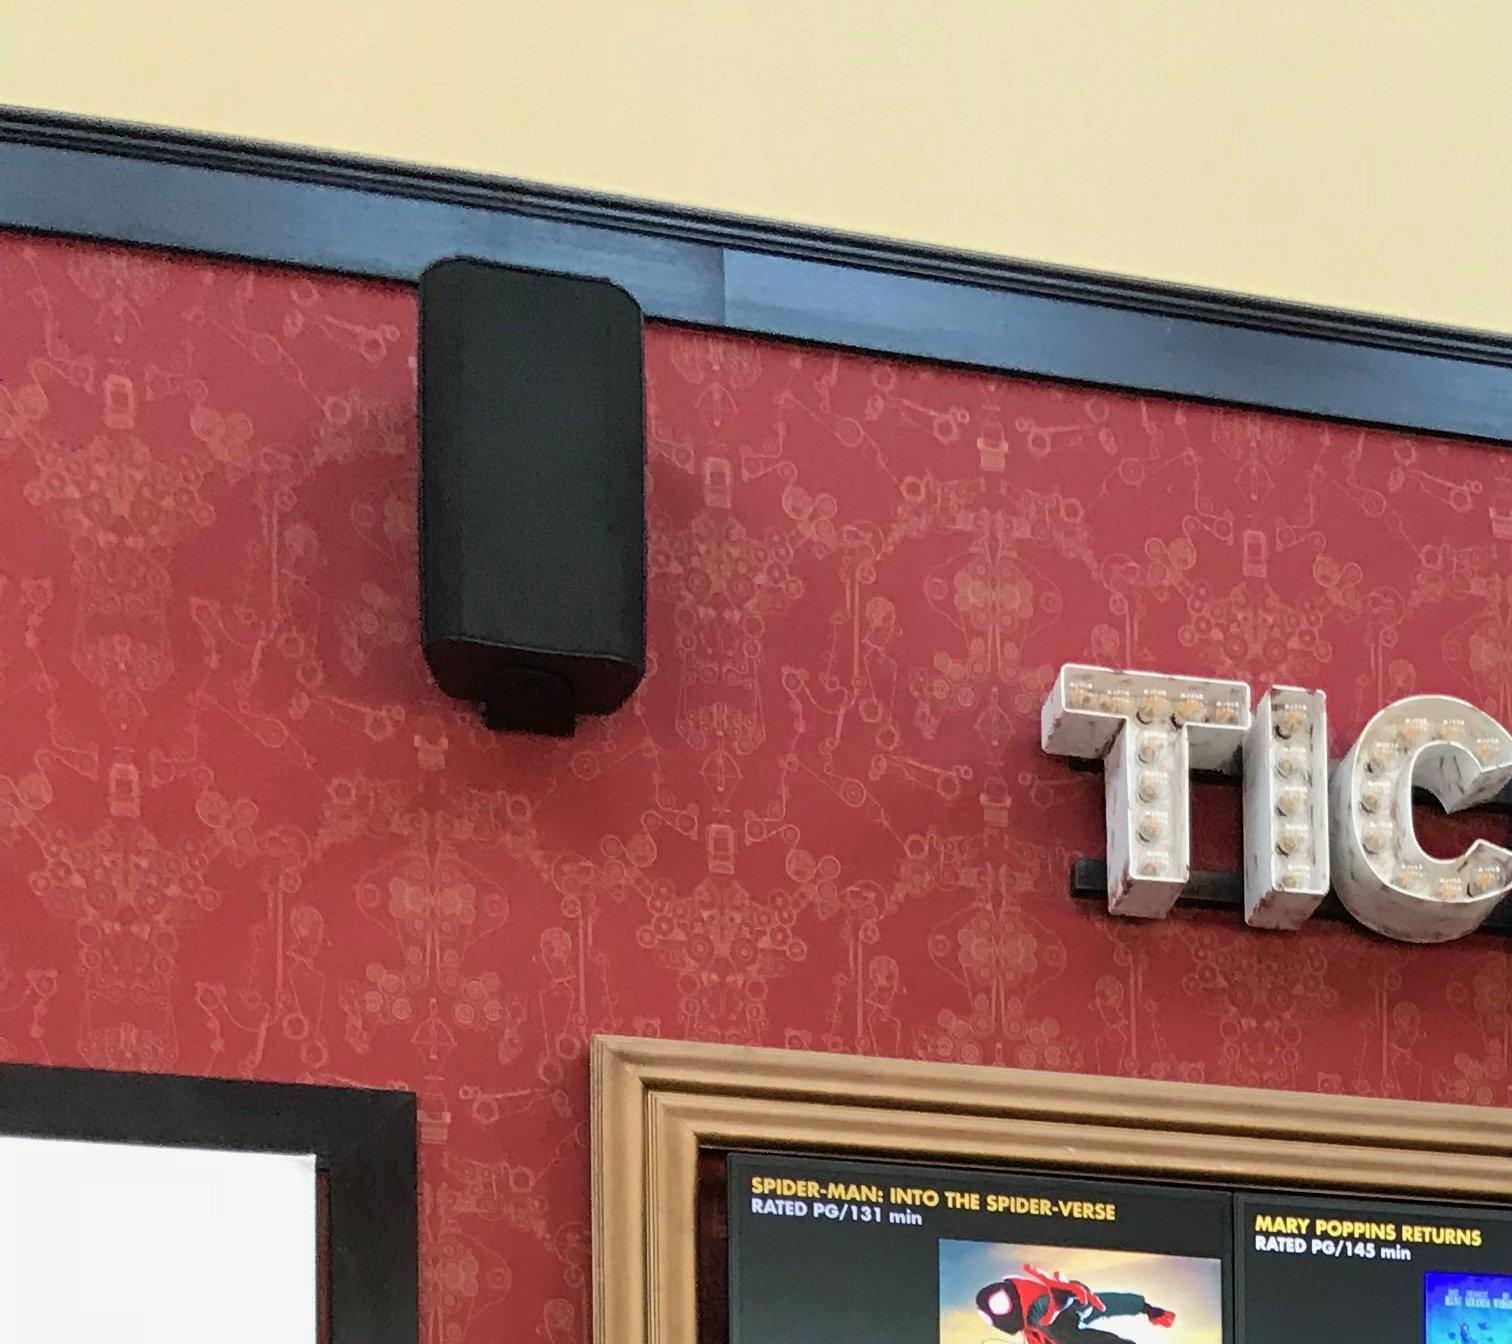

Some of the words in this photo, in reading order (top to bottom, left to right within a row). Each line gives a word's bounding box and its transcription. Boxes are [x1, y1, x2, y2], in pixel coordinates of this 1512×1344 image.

[751, 1177, 884, 1203] SPIDER-MAN:
[890, 1187, 939, 1207] INTO
[944, 1192, 980, 1210] THE
[986, 1195, 1116, 1221] SPIDER-VERSE
[751, 1198, 808, 1217] RATED
[813, 1203, 882, 1224] PG/131
[889, 1209, 923, 1226] min
[1255, 1216, 1309, 1236] MARY
[1315, 1219, 1396, 1240] POPPINS
[1401, 1225, 1482, 1246] RETURNS
[1255, 1237, 1307, 1253] RATED
[1312, 1240, 1375, 1259] PG/145
[1380, 1245, 1411, 1260] min
